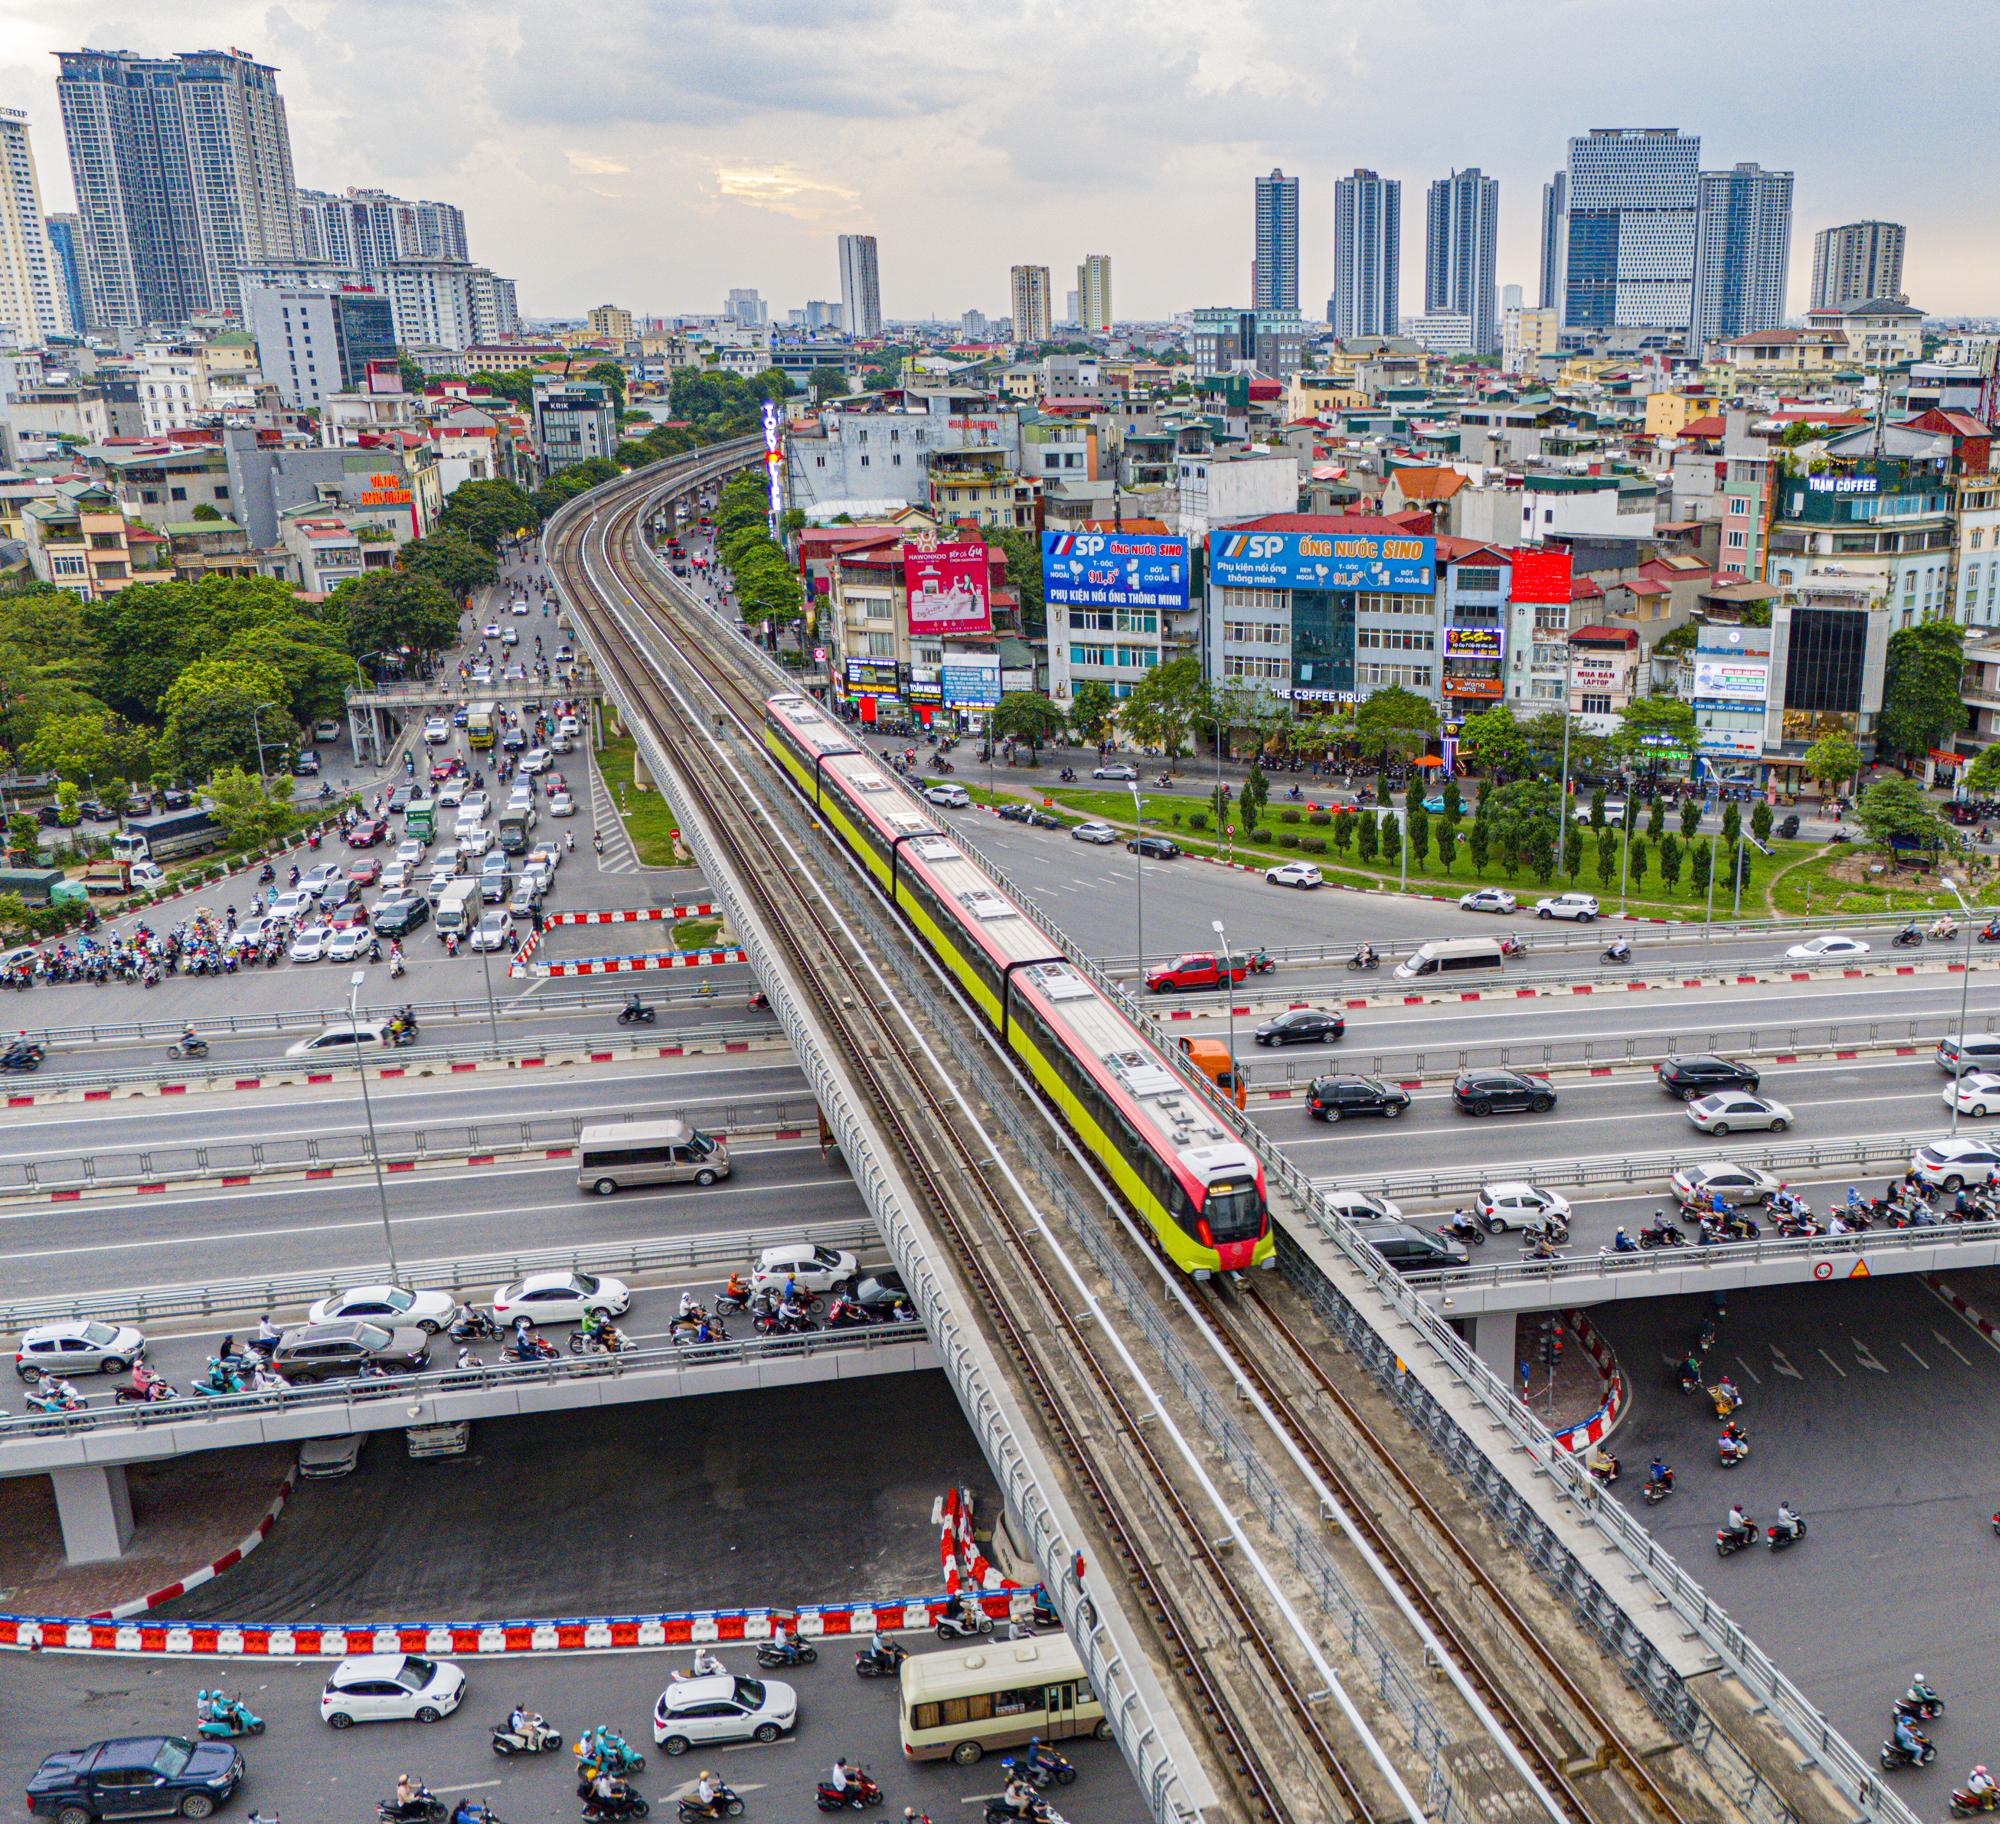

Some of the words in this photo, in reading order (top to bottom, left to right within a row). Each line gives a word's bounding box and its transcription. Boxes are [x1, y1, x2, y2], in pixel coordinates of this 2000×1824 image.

[1808, 477, 1834, 493] TRẠM
[1835, 478, 1878, 492] COFFEE
[1075, 535, 1105, 556] SP
[1110, 540, 1129, 555] ỐNG
[1131, 542, 1156, 555] NƯỚC
[1159, 543, 1182, 556] SINO
[1249, 535, 1284, 558] SP
[1299, 535, 1331, 557] ỐNG
[1334, 538, 1378, 558] NƯỚC
[1382, 540, 1423, 560] SINO
[1217, 562, 1234, 571] Phụ
[1235, 562, 1254, 573] kiện
[1255, 561, 1269, 572] nối
[1269, 562, 1287, 575] ống
[1227, 574, 1253, 584] thông
[1254, 575, 1276, 584] minh
[1050, 589, 1068, 603] PHỤ
[1069, 588, 1090, 603] KIỆN
[1091, 587, 1107, 602] NỐI
[1108, 588, 1127, 604] ỐNG
[1128, 591, 1156, 605] THÔNG
[1158, 593, 1182, 606] MINH
[1583, 678, 1609, 686] LAPTOP
[1597, 671, 1615, 679] BÁN
[1457, 685, 1476, 693] wang
[1464, 680, 1485, 689] Wang
[1271, 688, 1291, 699] THE
[1294, 690, 1335, 702] COFFEE
